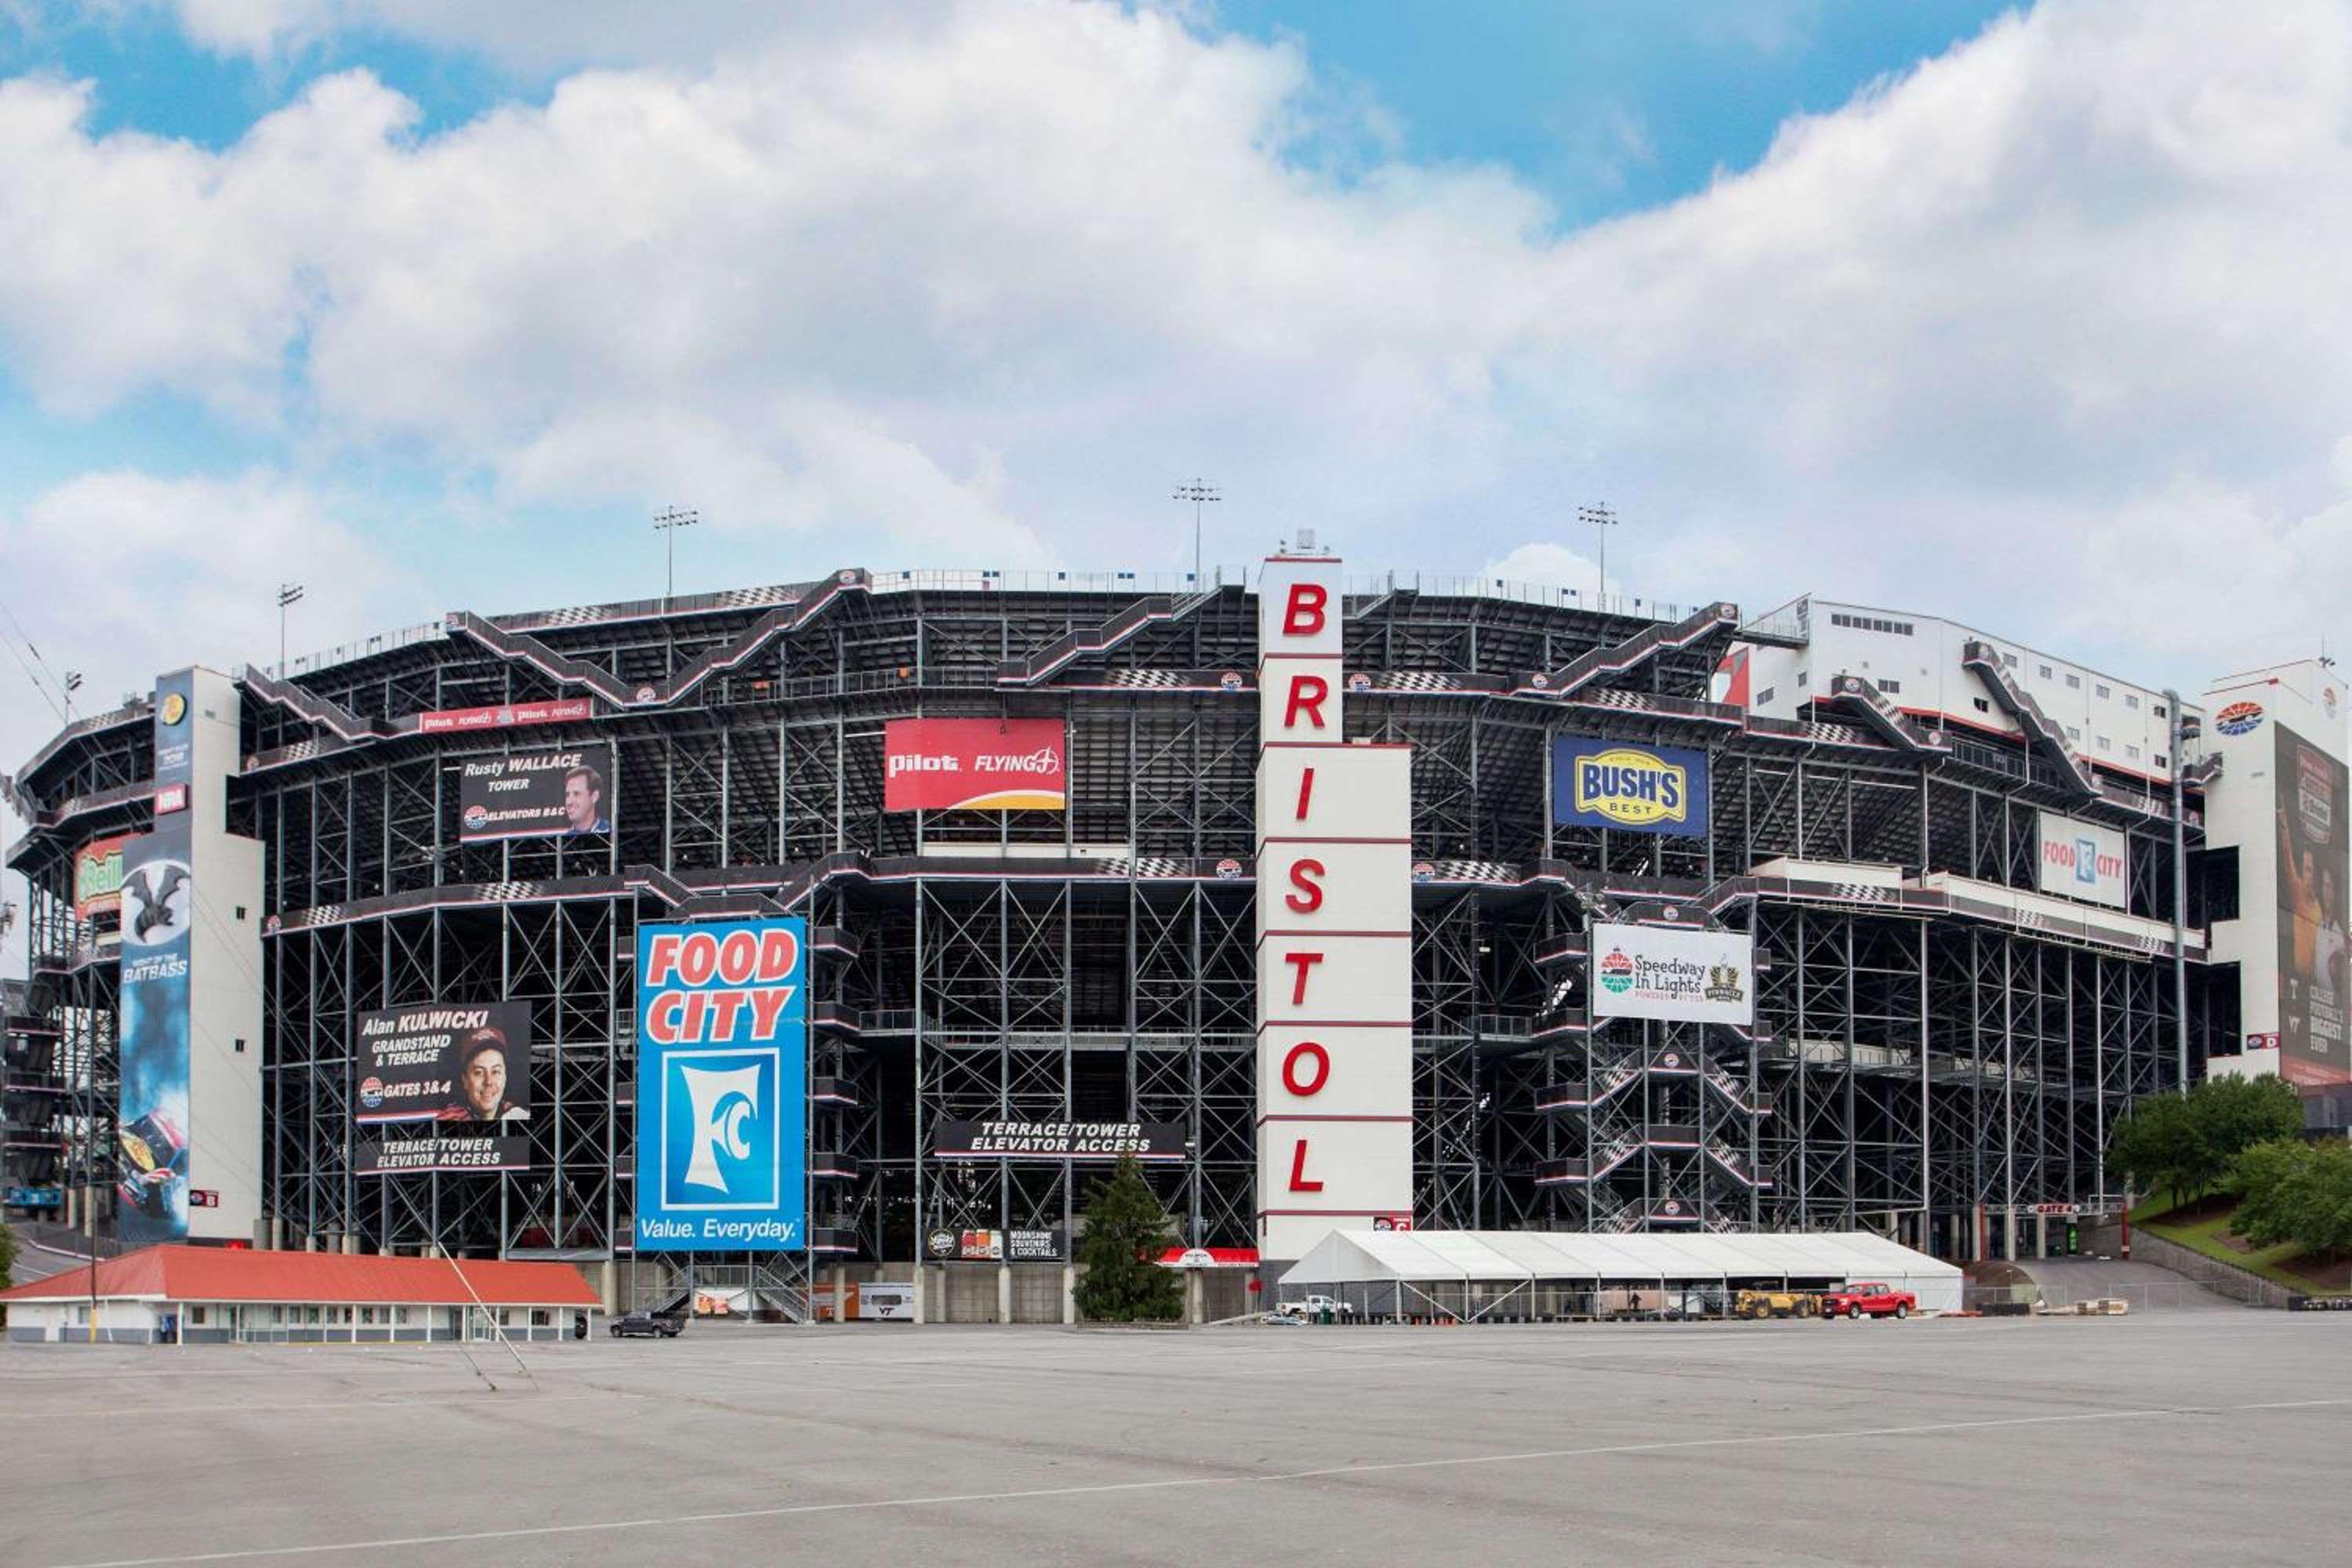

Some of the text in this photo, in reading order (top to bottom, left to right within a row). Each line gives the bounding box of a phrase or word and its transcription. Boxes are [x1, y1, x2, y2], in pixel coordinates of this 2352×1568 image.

[465, 753, 582, 780] Rusty WALLACE
[888, 754, 959, 779] pilot
[975, 755, 1034, 772] FLYING
[488, 779, 530, 793] TOWER
[1583, 764, 1679, 808] BUSH'S
[488, 808, 542, 822] ELEVATORS
[1610, 802, 1652, 815] BEST
[2044, 840, 2122, 879] FOOD CITY
[1283, 583, 1330, 1192] BRISTOL
[645, 928, 799, 987] FOOD
[1635, 954, 1705, 980] Speedway
[124, 960, 187, 984] BATBASS
[1635, 972, 1700, 1000] In Lights
[361, 1010, 489, 1036] Alan KULWICKI
[646, 985, 797, 1044] CITY
[2310, 1015, 2342, 1040] BIGGEST
[372, 1034, 452, 1054] GRANDSTAND
[2267, 1036, 2277, 1047] D
[2310, 1035, 2328, 1054] EVER
[376, 1049, 441, 1067] & TERRACE
[384, 1082, 421, 1098] GATES
[982, 1122, 1141, 1137] TERRACE/TOWER
[382, 1138, 494, 1155] TERRACE/TOWER
[971, 1138, 1151, 1152] ELEVATOR ACCESS
[376, 1152, 502, 1168] ELEVATOR ACCESS
[2037, 1205, 2063, 1214] GATE
[641, 1218, 797, 1243] Value. Everyday.
[1018, 1247, 1058, 1257] COCKTAILS
